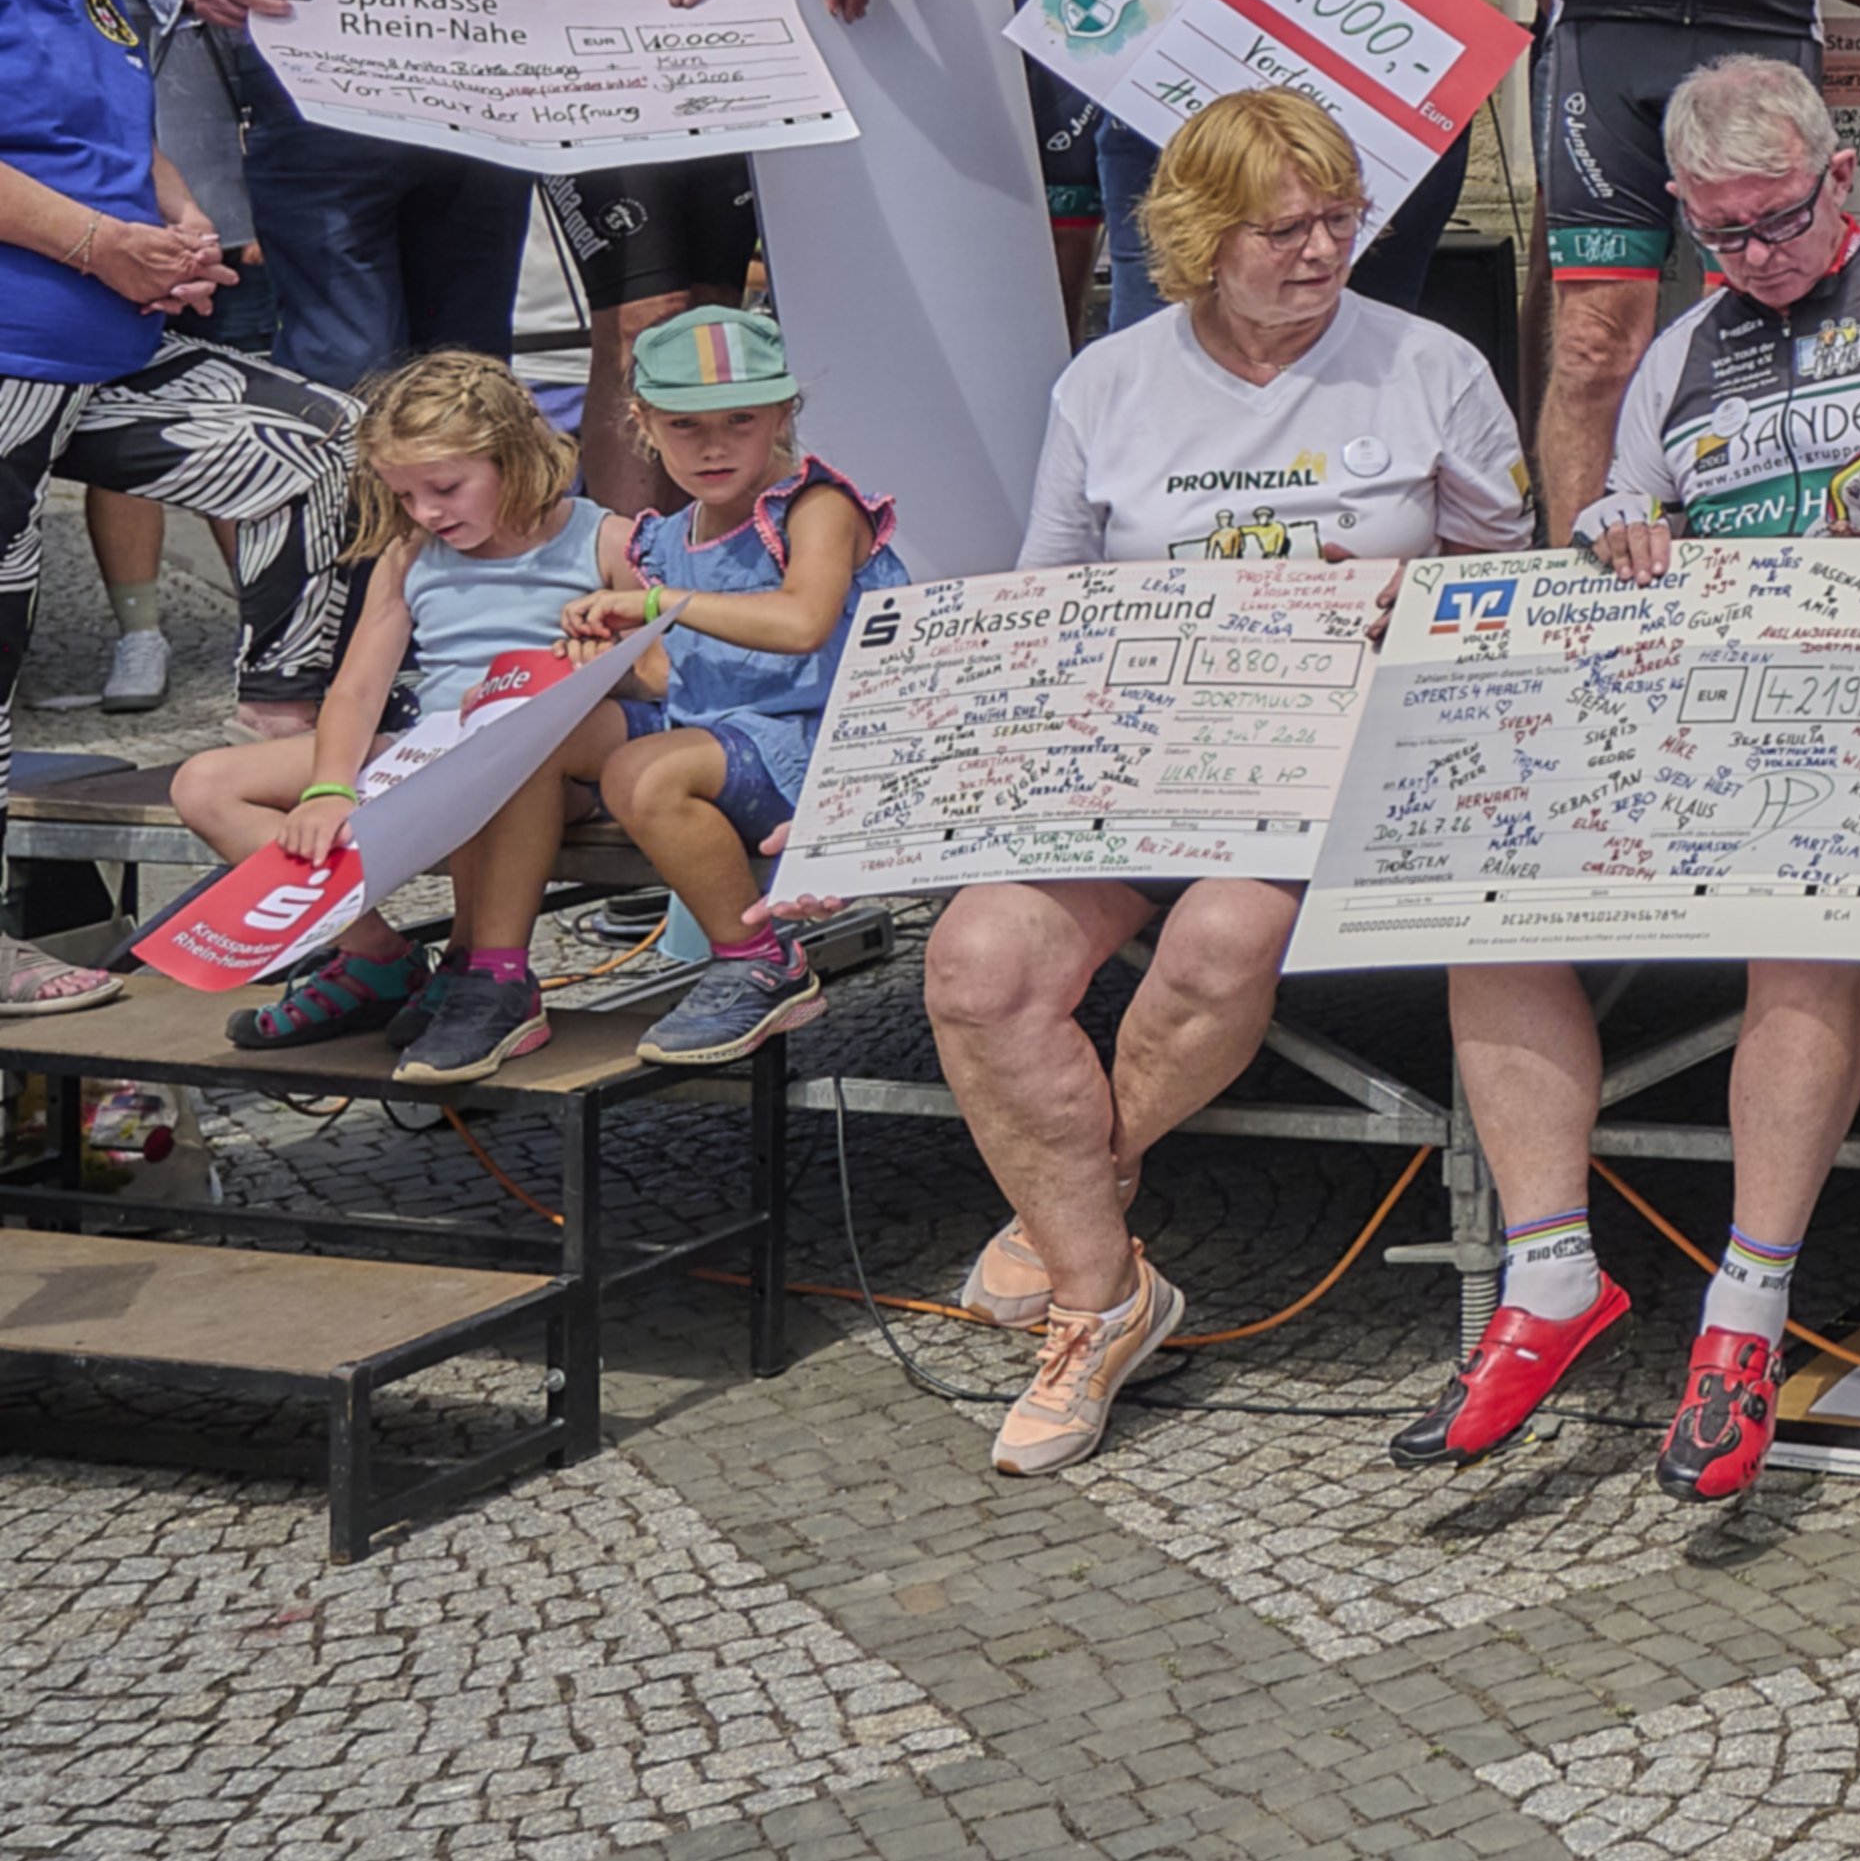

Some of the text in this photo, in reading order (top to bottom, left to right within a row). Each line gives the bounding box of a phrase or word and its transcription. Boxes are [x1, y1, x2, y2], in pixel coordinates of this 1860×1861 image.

[339, 12, 528, 45] Rhein-Nahe
[583, 37, 615, 47] EUR
[481, 104, 519, 122] der
[533, 103, 641, 124] Hoffnung
[1420, 100, 1454, 132] Euro
[1166, 468, 1319, 494] PROVINZIAL
[1459, 556, 1542, 580] VOR-TOUR
[1702, 548, 1741, 569] TINA
[1141, 577, 1187, 597] LENA
[1749, 583, 1793, 598] PETER
[1526, 597, 1654, 628] Volksbank
[1797, 598, 1839, 620] AMIR
[908, 594, 1217, 650] Sparkasse Dortmund
[1541, 623, 1596, 642] PETRA
[1128, 656, 1159, 668] EUR
[1699, 647, 1775, 664] HEIDRUN
[1414, 664, 1571, 685] Zahlen Sie gegen diesen Scheck
[973, 691, 1009, 706] TEAM
[1191, 690, 1315, 709] DORTMUND
[1403, 679, 1544, 707] EXPERTS 4 HEALTH
[1696, 690, 1728, 702] EUR
[1438, 706, 1491, 724] MARK
[991, 719, 1066, 738] SEBASTIAN
[1587, 748, 1637, 768] GEORG
[1658, 736, 1700, 760] MIKE
[1653, 766, 1697, 791] SVEN
[1455, 786, 1530, 811] HERWARTH
[1547, 769, 1644, 820] SEBASTIAN
[1660, 793, 1718, 820] KLAUS
[1032, 830, 1107, 846] VOR-TOUR
[1017, 851, 1094, 866] HOFFNUNG
[1480, 857, 1541, 880] RAINER
[1353, 871, 1454, 888] Verwendungszweck
